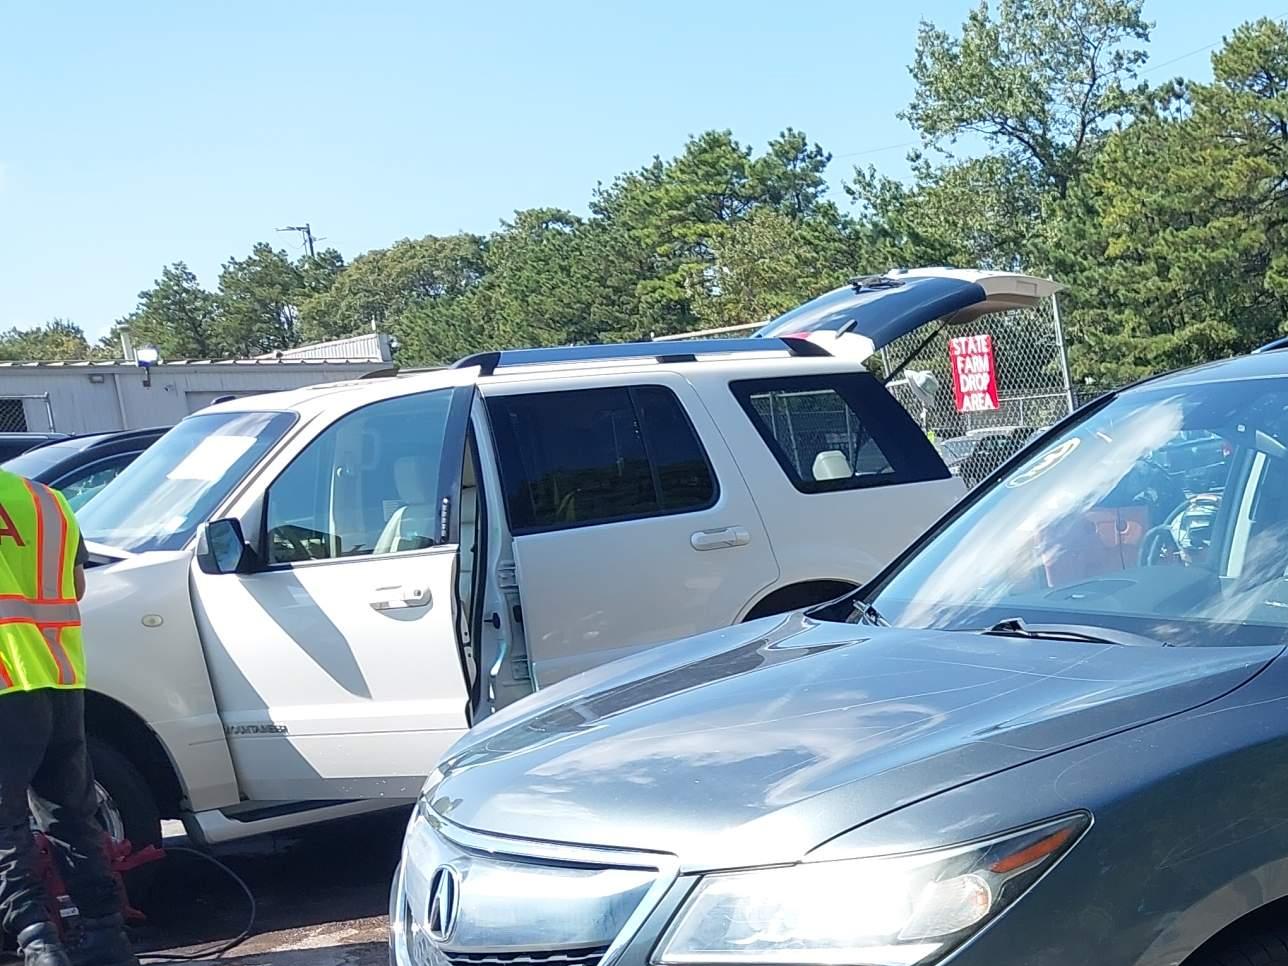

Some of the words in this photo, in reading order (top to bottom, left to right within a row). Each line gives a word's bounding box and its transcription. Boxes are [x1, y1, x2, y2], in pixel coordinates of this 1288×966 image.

[952, 335, 988, 355] STATE
[957, 354, 989, 373] FARM
[960, 373, 990, 392] DROP
[962, 392, 995, 411] AREA
